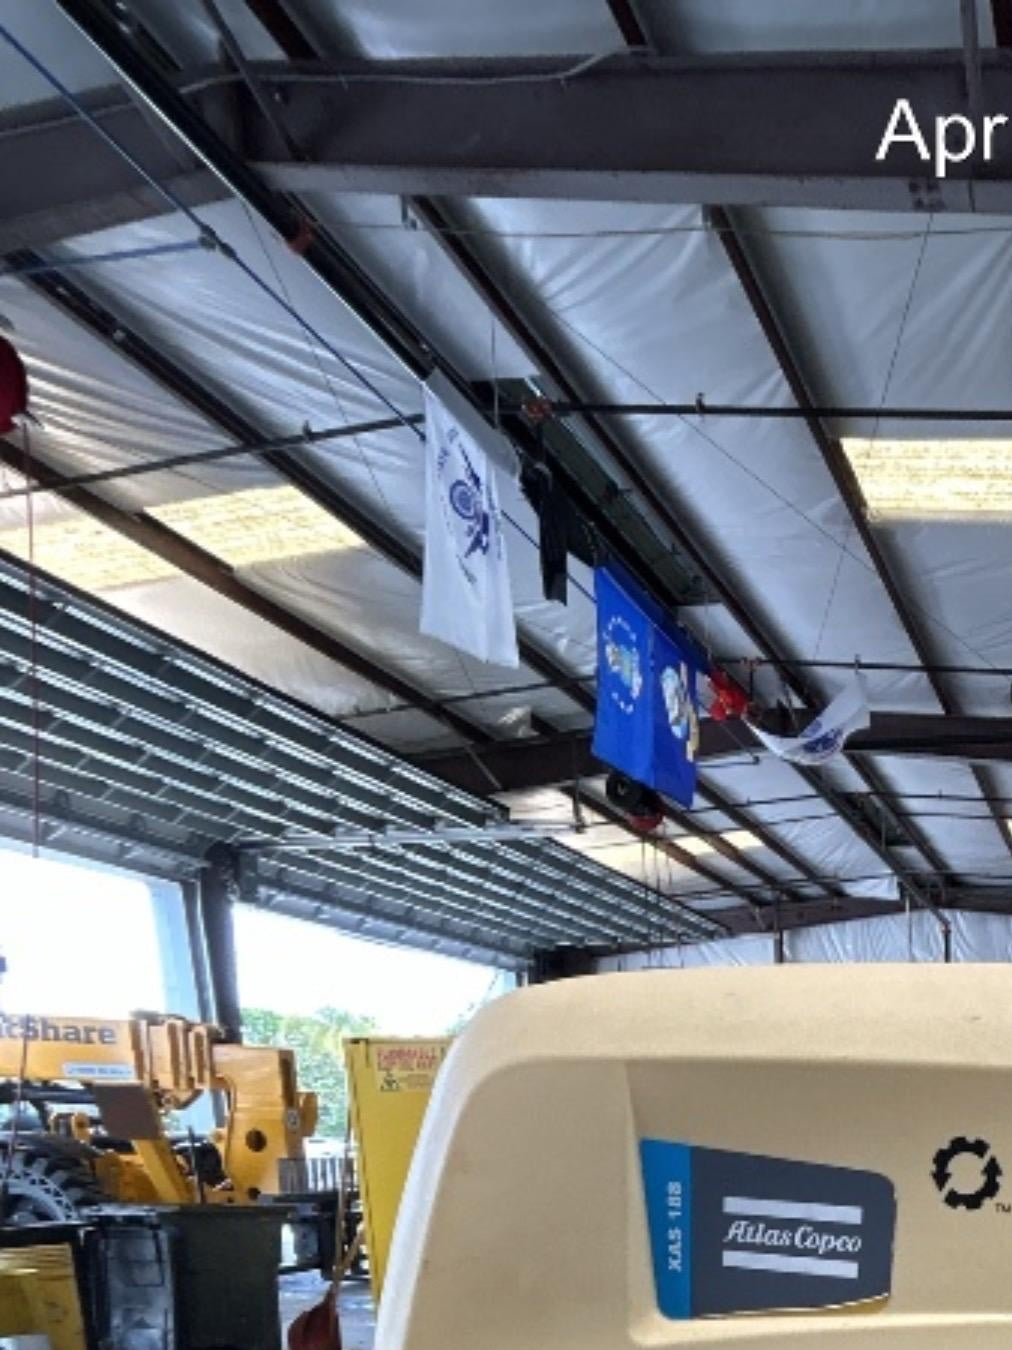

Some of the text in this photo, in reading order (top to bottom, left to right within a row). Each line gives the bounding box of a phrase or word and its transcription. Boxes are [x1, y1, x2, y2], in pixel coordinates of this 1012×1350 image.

[668, 1181, 683, 1272] XAS 188
[723, 1219, 863, 1255] Atlas Copco
